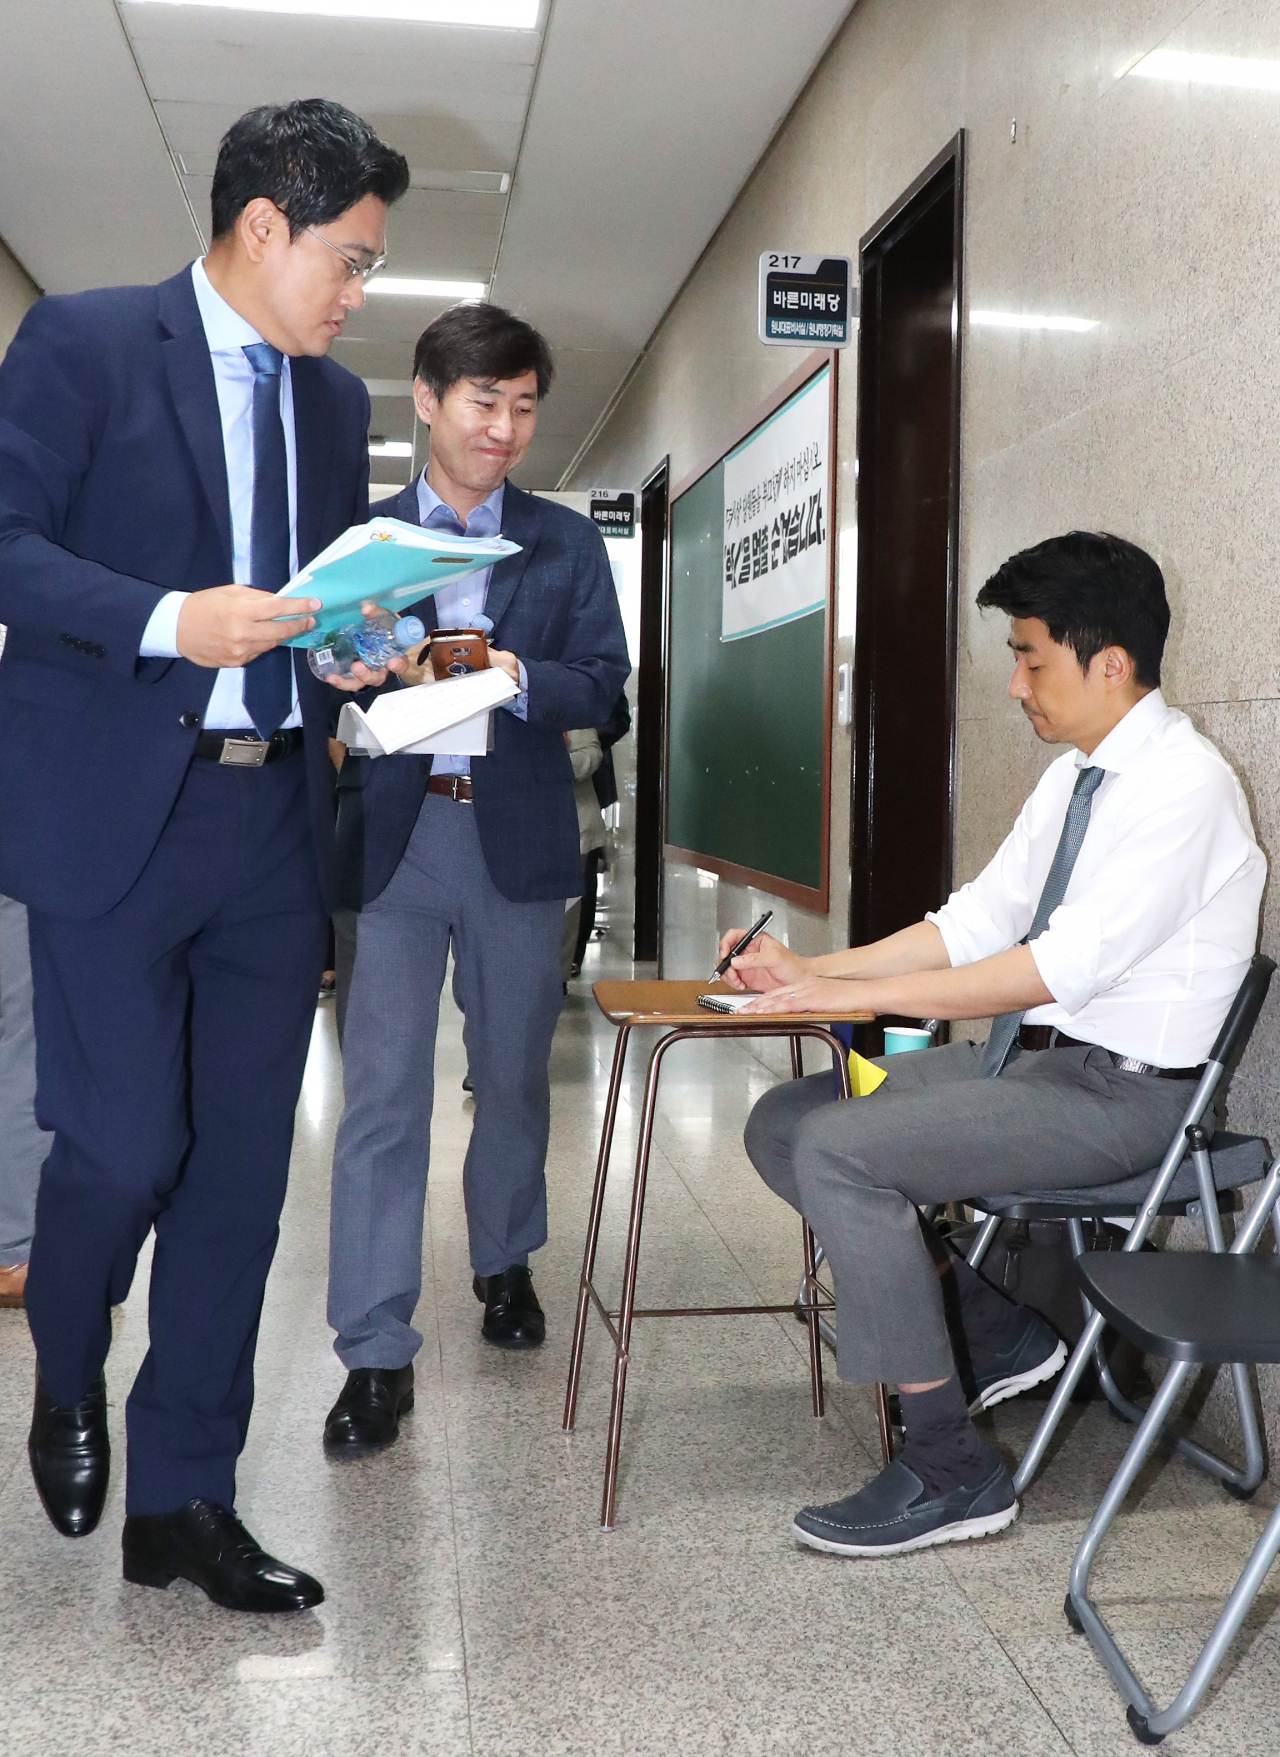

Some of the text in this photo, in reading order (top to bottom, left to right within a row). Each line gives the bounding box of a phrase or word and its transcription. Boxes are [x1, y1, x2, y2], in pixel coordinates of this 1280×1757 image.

[768, 254, 801, 269] 217
[773, 290, 841, 312] 바른미래당
[783, 461, 796, 495] 하지
[591, 490, 609, 498] 216
[593, 510, 631, 522] 바른미래당
[752, 523, 769, 580] 멈출
[771, 516, 780, 571] 수
[780, 487, 826, 565] 없습니다.
